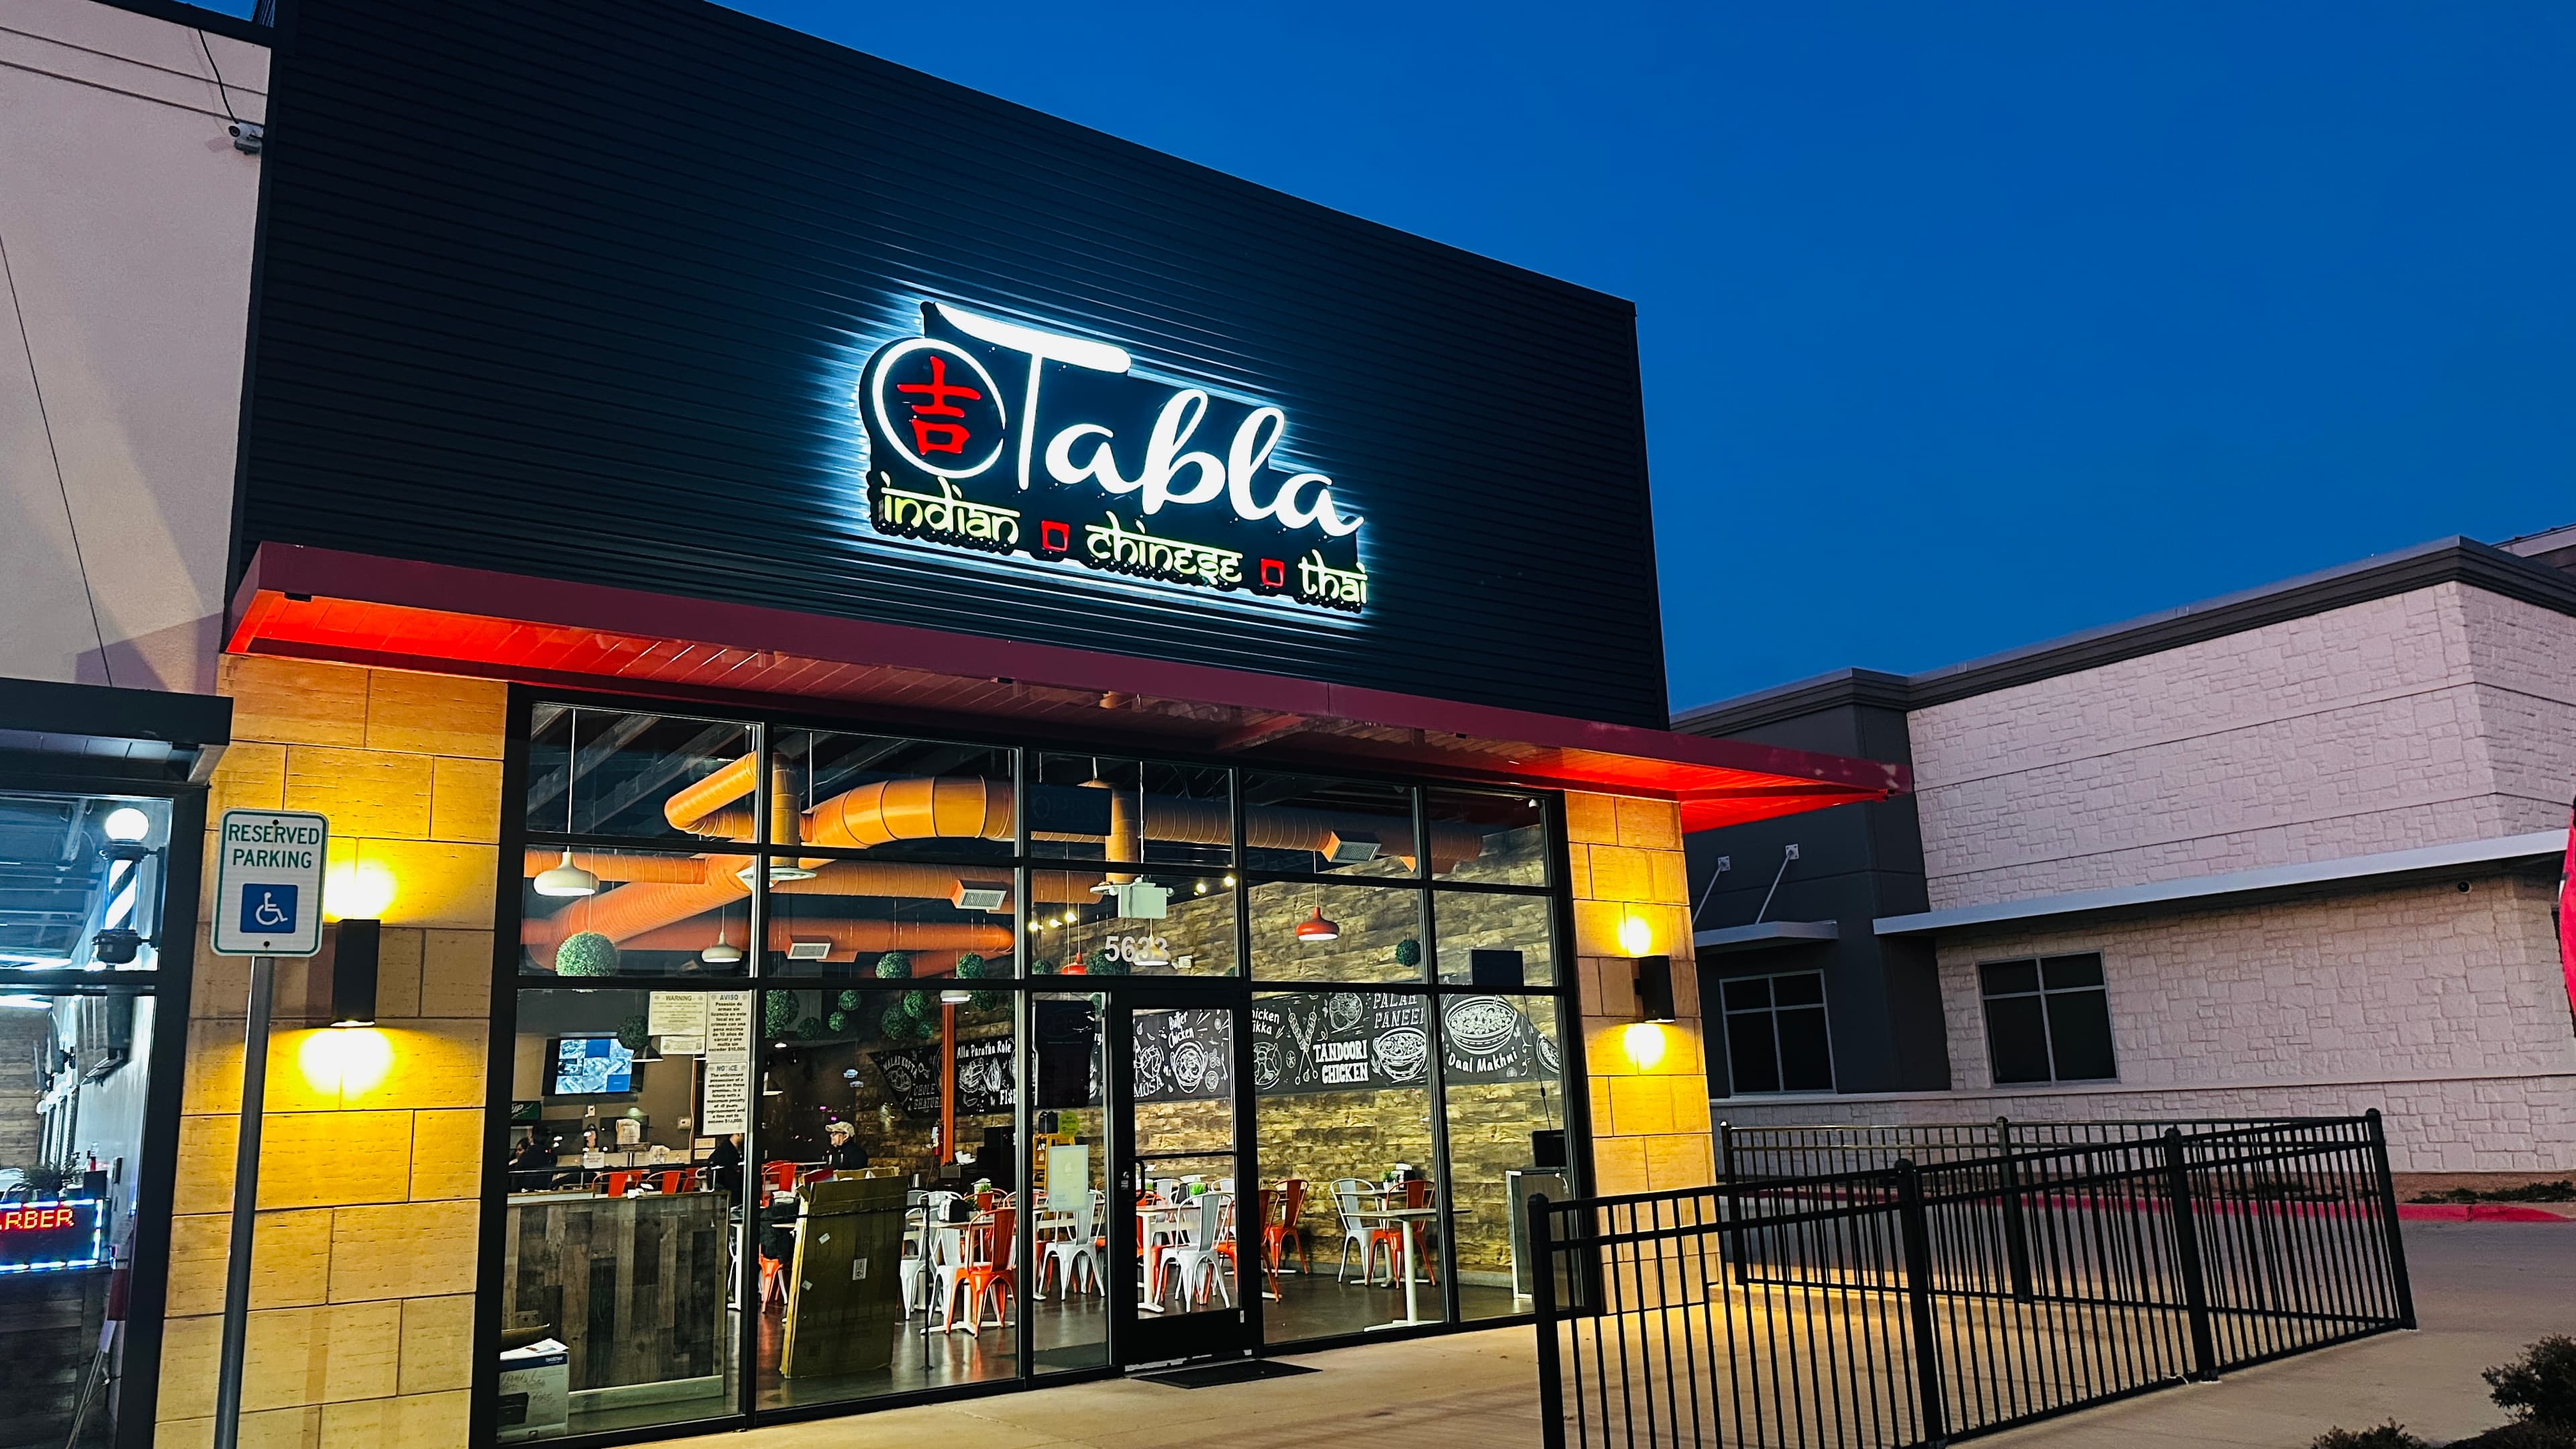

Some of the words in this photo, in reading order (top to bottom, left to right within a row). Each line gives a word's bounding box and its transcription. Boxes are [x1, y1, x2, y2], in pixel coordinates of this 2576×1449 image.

[897, 356, 981, 455] 吉
[934, 302, 1364, 537] Tabla
[881, 471, 1020, 544] indian
[1085, 511, 1243, 588] chinese
[1299, 549, 1368, 604] thai
[229, 824, 319, 845] RESERVED
[233, 849, 312, 869] PARKING
[1105, 936, 1170, 962] 5633
[1169, 1010, 1189, 1030] Butter
[1252, 1020, 1272, 1036] ikka
[971, 1041, 996, 1057] Paratha
[997, 1039, 1012, 1053] Role
[1169, 1027, 1195, 1049] Chicken
[1313, 1040, 1368, 1063] TANDOORI
[1448, 1052, 1473, 1073] Daal
[1477, 1046, 1518, 1073] Makhni
[1322, 1062, 1368, 1084] CHICKEN
[914, 1083, 935, 1095] CHOLE
[1134, 1074, 1165, 1097] MOSA
[0, 1209, 75, 1230] RBER
